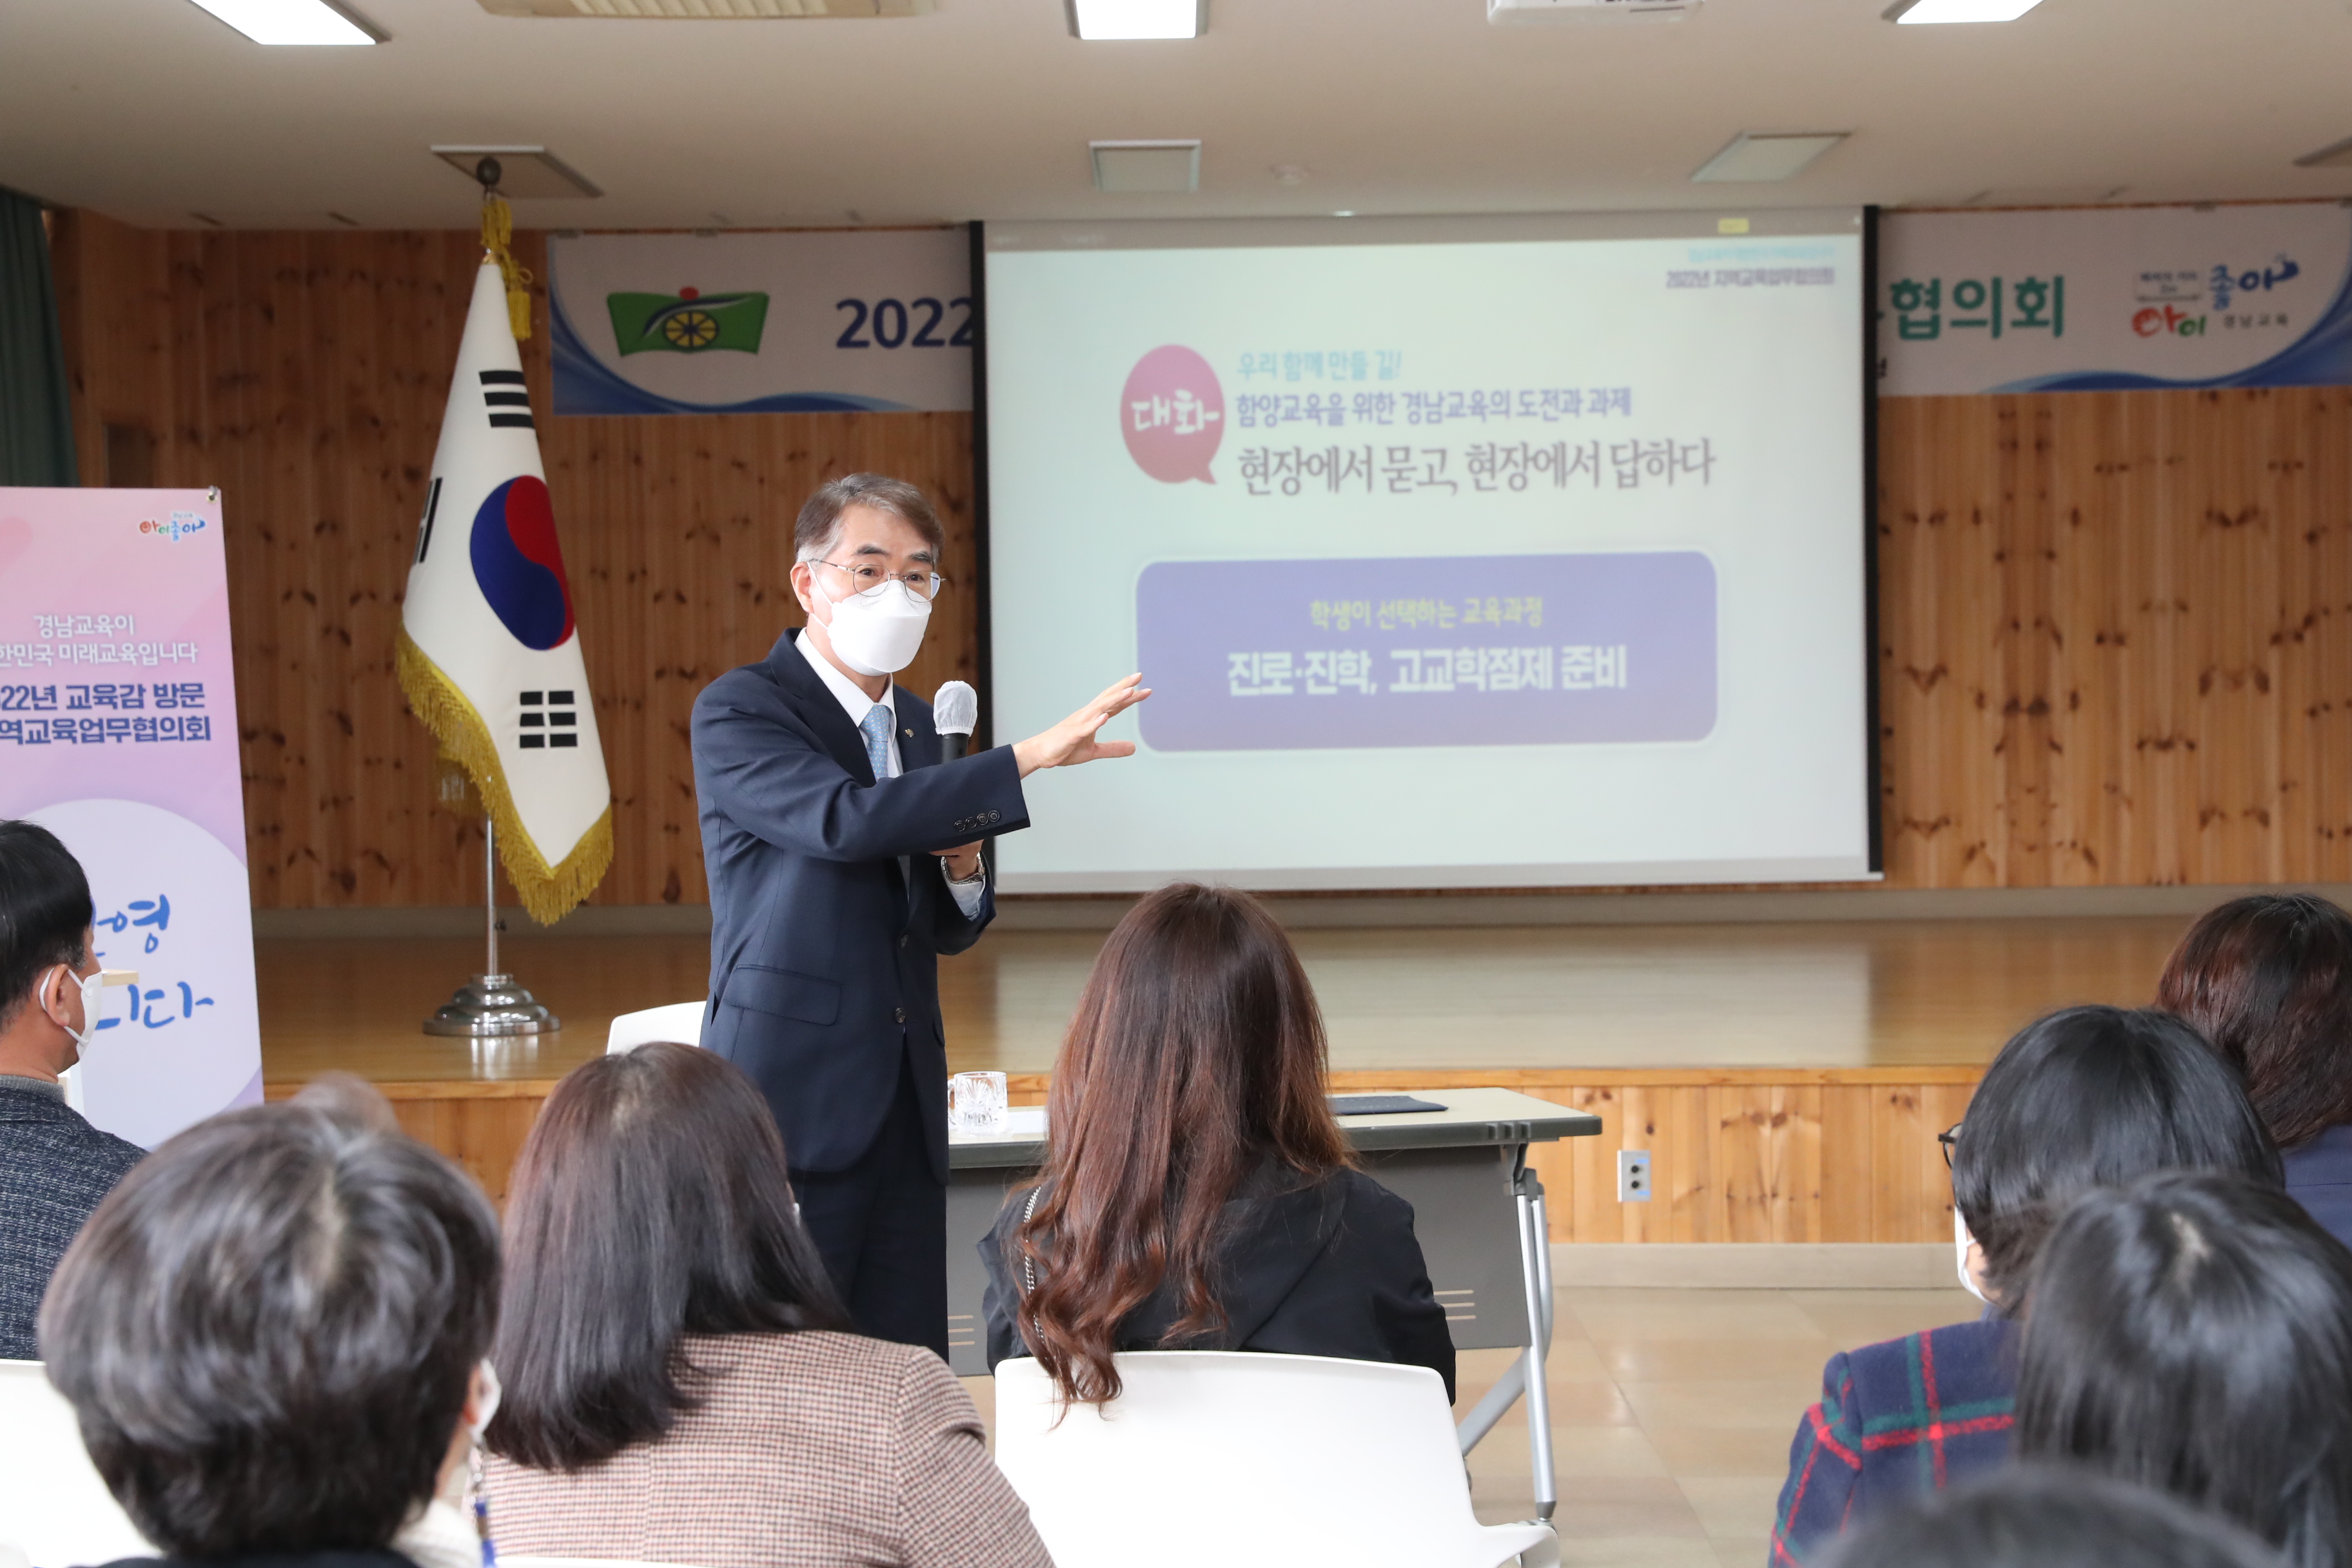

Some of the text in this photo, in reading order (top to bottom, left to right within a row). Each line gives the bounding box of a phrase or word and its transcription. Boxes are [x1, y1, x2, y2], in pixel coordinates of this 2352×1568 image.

[836, 298, 973, 349] 2022
[1890, 275, 2064, 340] 협의회
[1237, 352, 1277, 380] 우리
[1282, 351, 1324, 382] 함께
[1130, 389, 1220, 435] 대화
[1236, 387, 1632, 427] 함양교육을 위한 경남교육의 도전과 과제
[1238, 436, 1717, 496] 현장에서 묻고, 현장에서 답하다
[34, 614, 135, 639] 경남교육이
[1310, 596, 1544, 631] 학생이 선택하는 교육과정
[59, 642, 198, 667] 미래교육입니다
[1389, 646, 1553, 693] 고교학점제
[1561, 645, 1628, 691] 준비
[66, 683, 146, 710] 교육감
[153, 683, 206, 709] 방문
